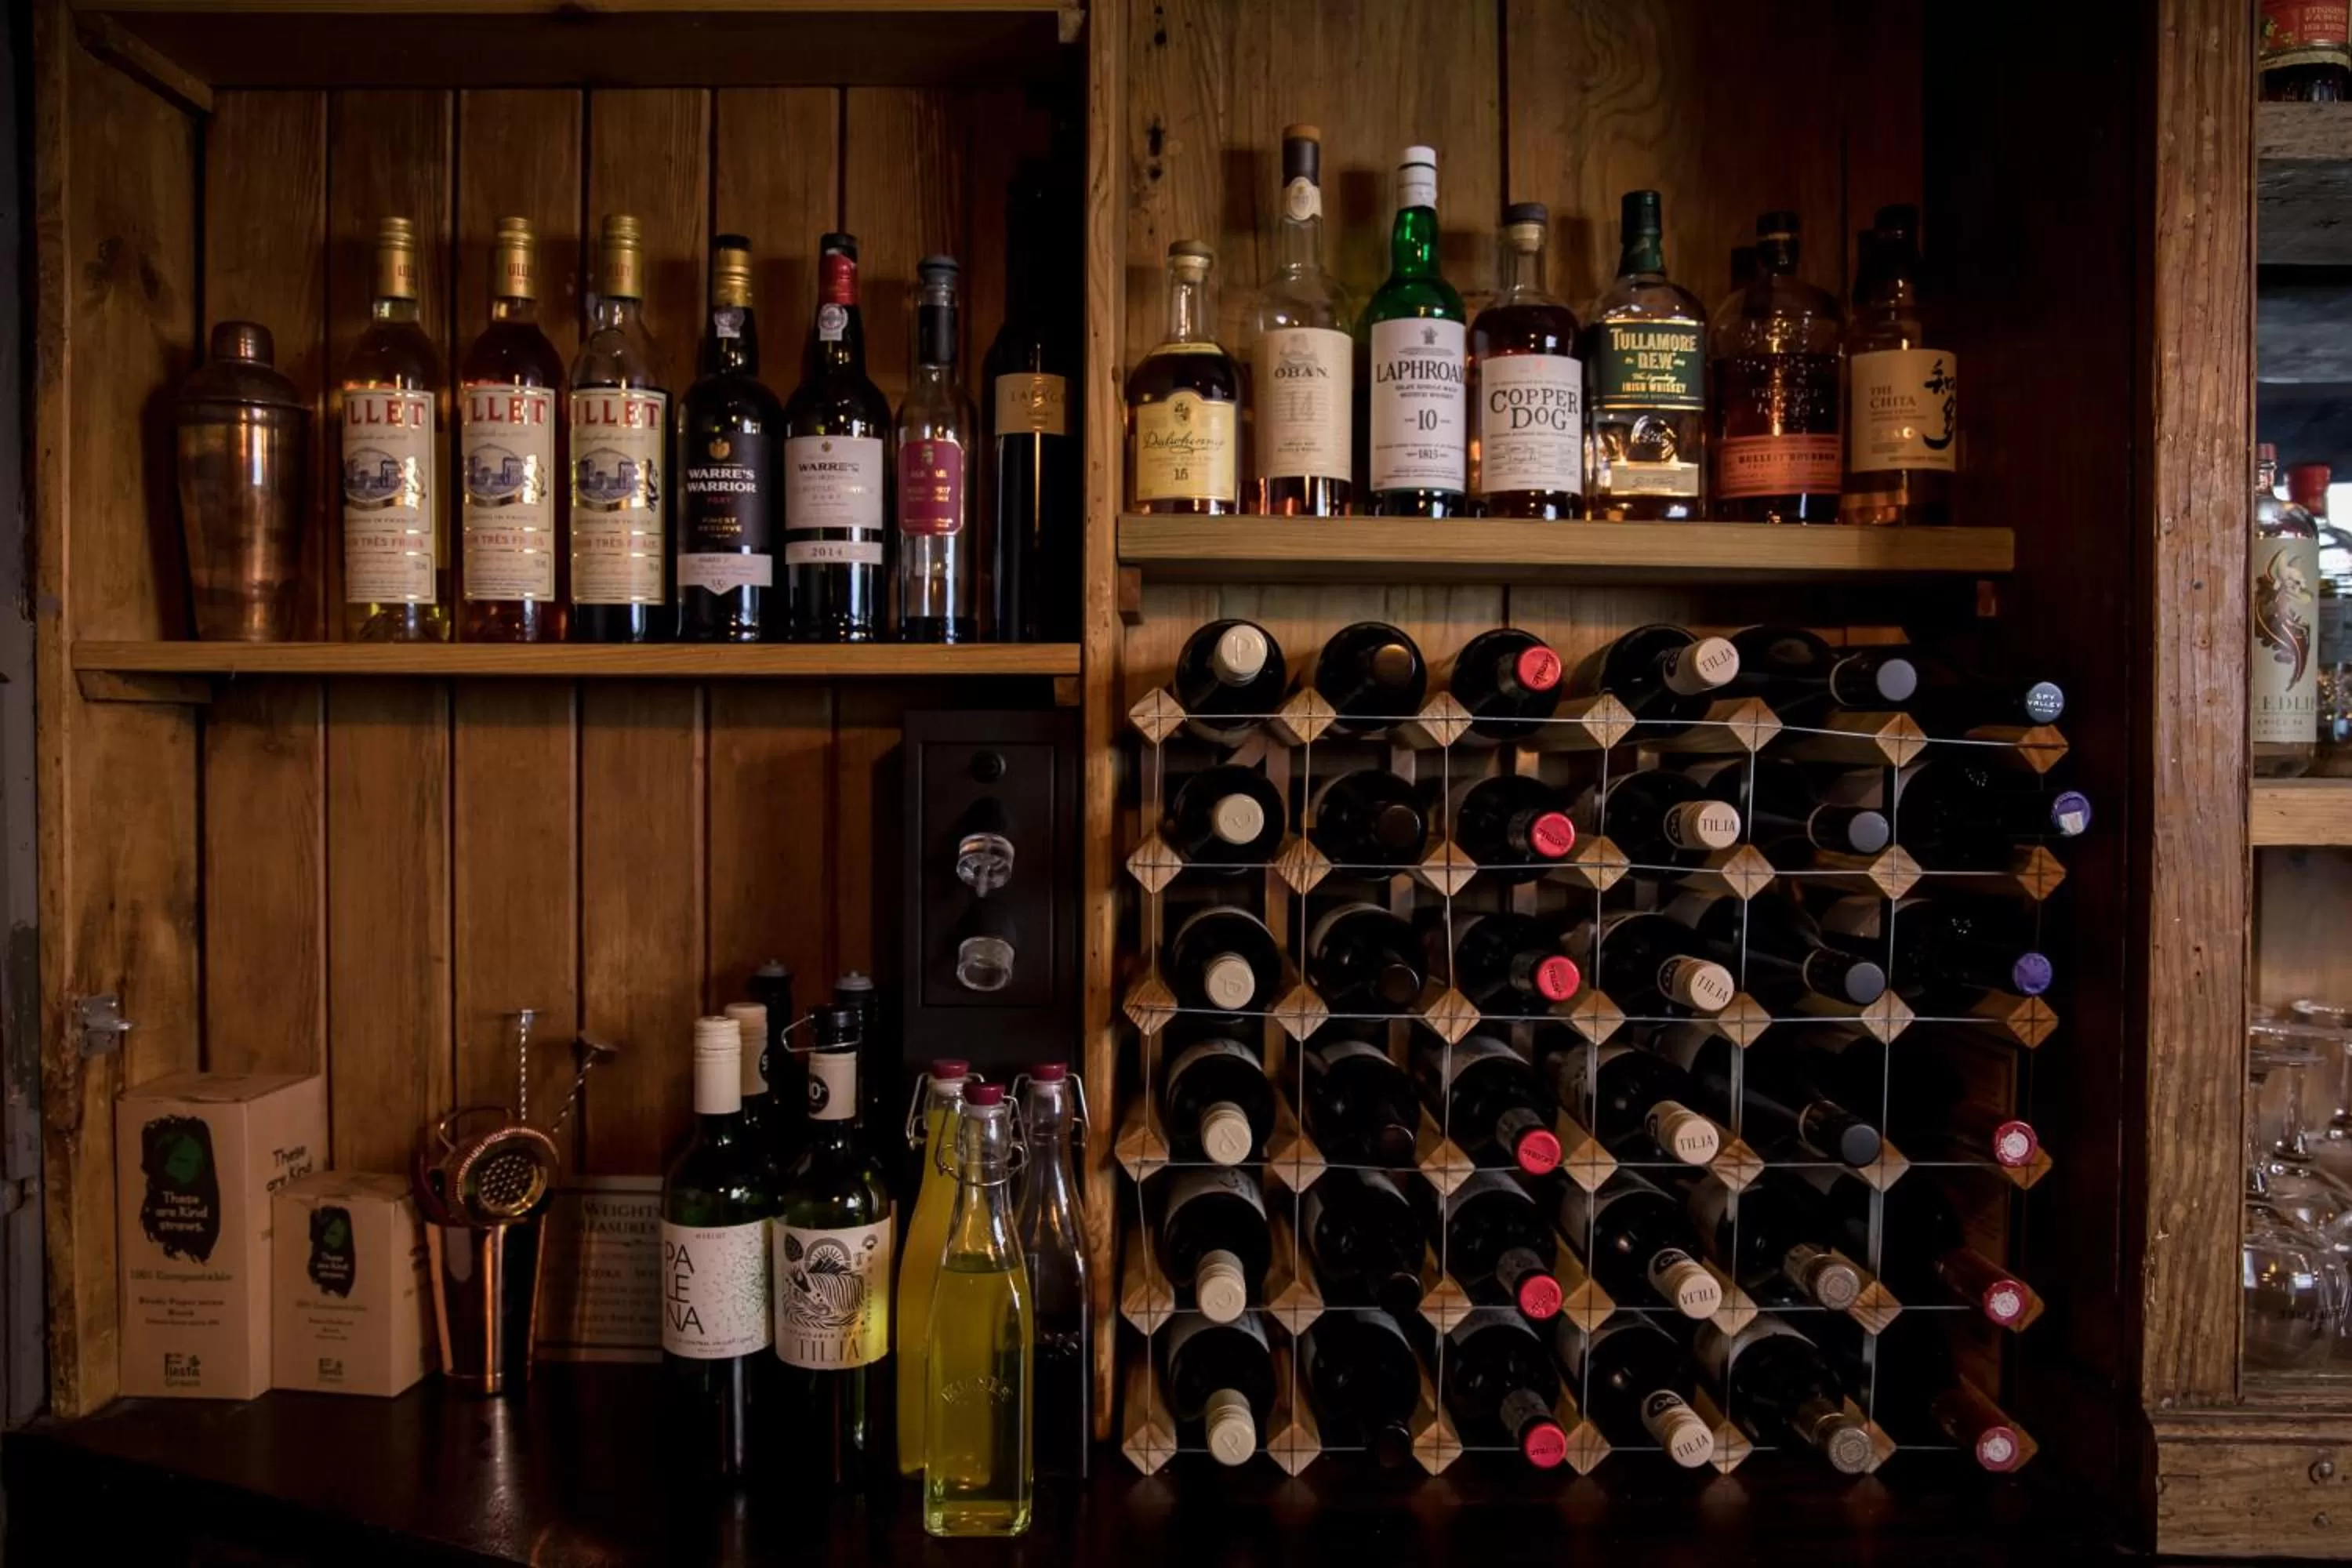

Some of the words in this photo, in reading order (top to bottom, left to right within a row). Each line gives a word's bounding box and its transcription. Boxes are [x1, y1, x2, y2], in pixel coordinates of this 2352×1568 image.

[1609, 328, 1697, 352] TULLAMORE
[1274, 367, 1330, 379] OBAN
[1377, 360, 1465, 383] LAPHROAI
[1622, 382, 1646, 392] IRISH
[1491, 388, 1578, 415] COPPER
[1870, 395, 1917, 408] CHITA
[347, 399, 425, 427] LLET
[470, 397, 547, 426] LLET
[1418, 409, 1437, 430] 10
[1510, 406, 1566, 430] DOG
[687, 468, 755, 480] WARRE'S
[798, 462, 859, 473] WARRE'S
[687, 481, 757, 493] WARRIOR
[811, 546, 844, 557] 2014
[1700, 648, 1734, 672] TILIA
[2027, 699, 2060, 708] VALLEY
[1701, 818, 1735, 833] TILIA
[1696, 975, 1728, 1003] TILIA
[1678, 1135, 1715, 1151] TILIA
[272, 1145, 307, 1167] These
[163, 1190, 201, 1205] These
[155, 1208, 176, 1218] are
[1681, 1287, 1716, 1306] TILIA
[1674, 1434, 1710, 1458] TILIA
